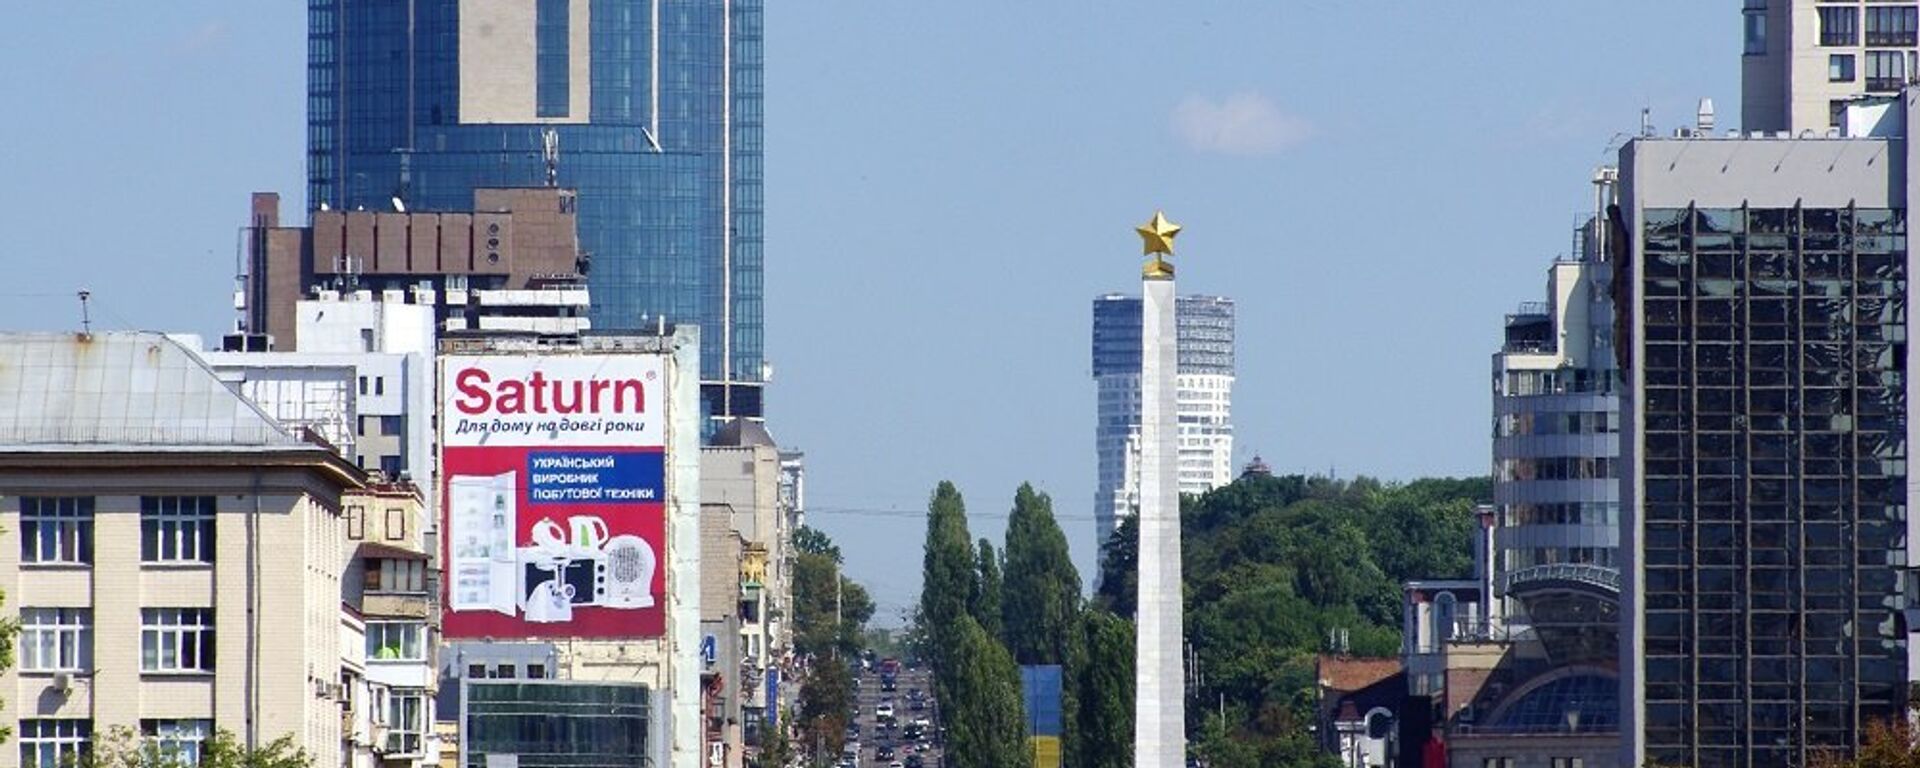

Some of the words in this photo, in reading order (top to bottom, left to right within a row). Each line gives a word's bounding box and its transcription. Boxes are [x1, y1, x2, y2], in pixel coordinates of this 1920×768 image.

[455, 367, 645, 414] Saturn
[456, 419, 487, 434] Для
[491, 419, 533, 434] дому
[536, 423, 557, 433] на
[559, 418, 602, 432] довгі
[604, 422, 645, 434] роки
[533, 456, 615, 469] УКРАЇНСЬКИЙ
[532, 473, 599, 484] ВИРОБНИК
[533, 487, 602, 499] ПОБУТОВОЇ
[604, 488, 655, 499] ТЕХНІКИ
